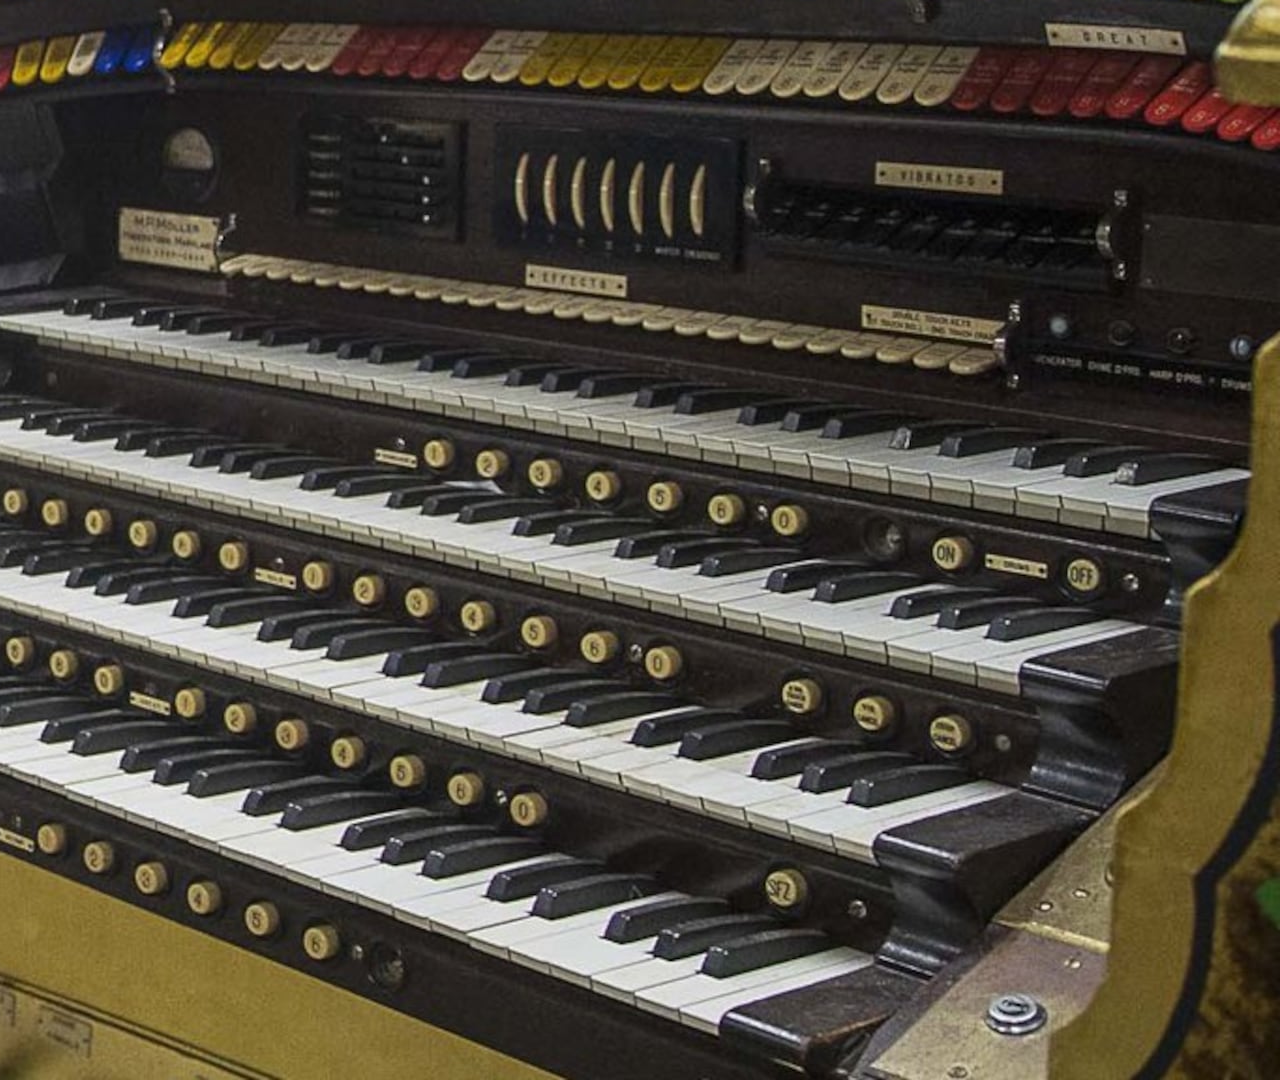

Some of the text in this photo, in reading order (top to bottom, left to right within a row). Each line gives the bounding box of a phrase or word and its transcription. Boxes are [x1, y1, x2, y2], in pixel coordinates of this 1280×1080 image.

[1082, 31, 1148, 46] GREAT
[542, 273, 608, 290] EFFECTS
[483, 458, 491, 473] 2
[535, 467, 545, 481] 3
[593, 480, 603, 493] 4
[655, 490, 664, 505] 5
[717, 504, 725, 518] 6
[780, 514, 788, 528] 0
[937, 545, 957, 563] ON
[1070, 567, 1095, 585] OFF
[360, 584, 368, 599] 2
[412, 595, 421, 611] 3
[468, 609, 476, 624] 4
[529, 624, 538, 639] 5
[590, 641, 598, 657] 6
[655, 654, 662, 670] 0
[230, 711, 238, 726] 2
[282, 728, 291, 744] 3
[338, 744, 347, 759] 4
[397, 764, 406, 780] 5
[456, 783, 464, 797] 6
[519, 803, 527, 818] 0
[90, 852, 98, 868] 2
[141, 873, 151, 887] 3
[194, 891, 202, 907] 4
[251, 911, 261, 927] 5
[311, 936, 320, 952] 6
